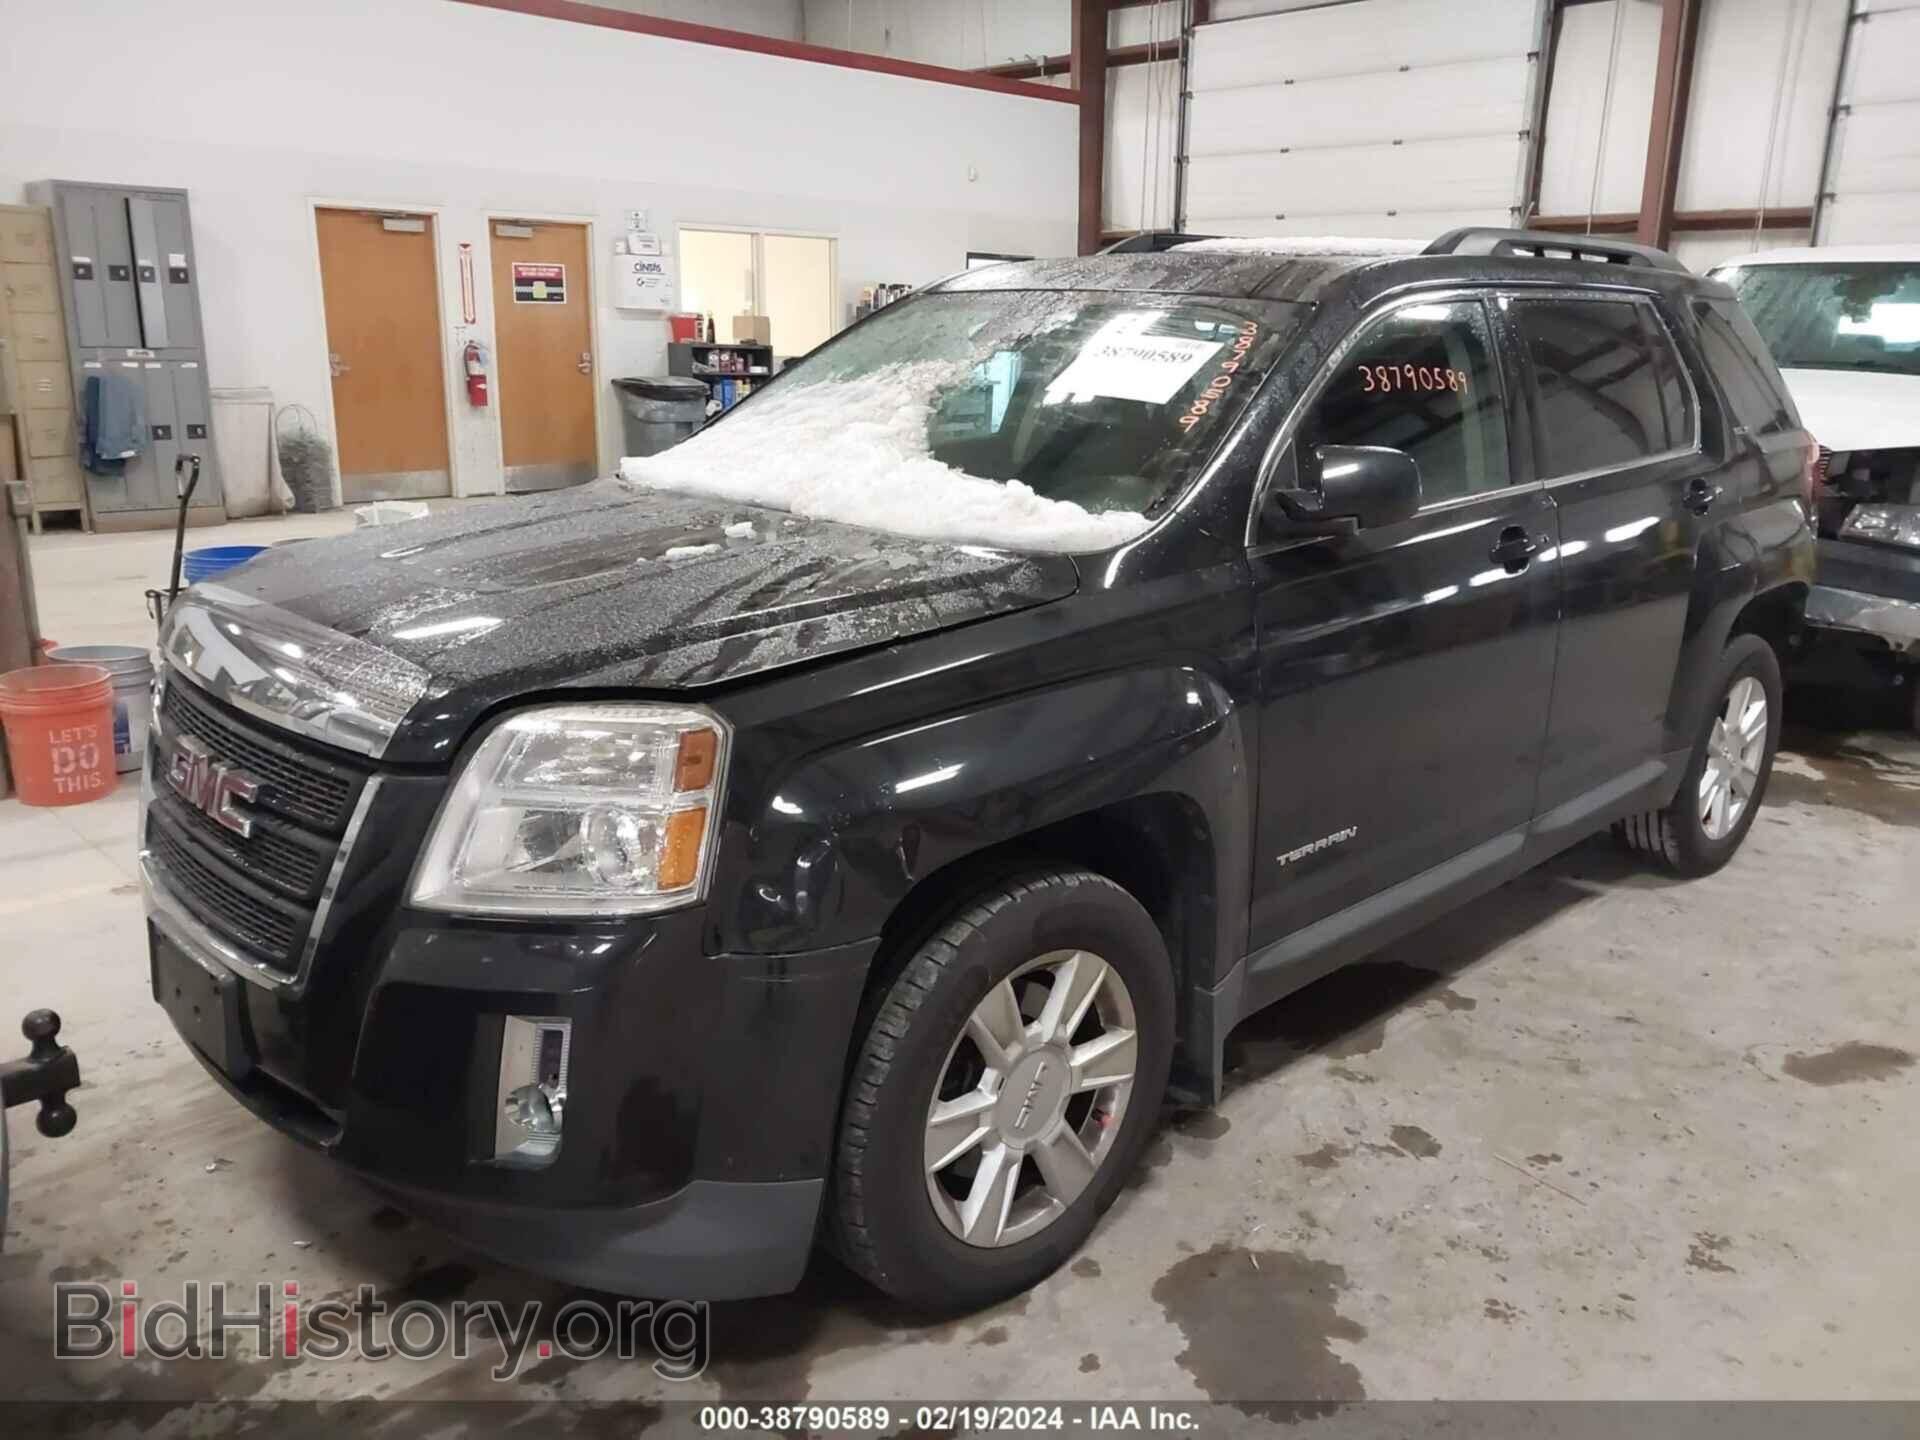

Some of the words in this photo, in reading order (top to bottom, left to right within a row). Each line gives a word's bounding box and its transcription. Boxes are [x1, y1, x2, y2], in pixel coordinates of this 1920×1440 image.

[1178, 320, 1259, 433] 38790589
[1357, 363, 1468, 396] 38790589
[48, 725, 97, 744] LET'S
[51, 742, 99, 775] DO
[165, 735, 258, 839] GMC
[1275, 825, 1359, 866] TERRAIN
